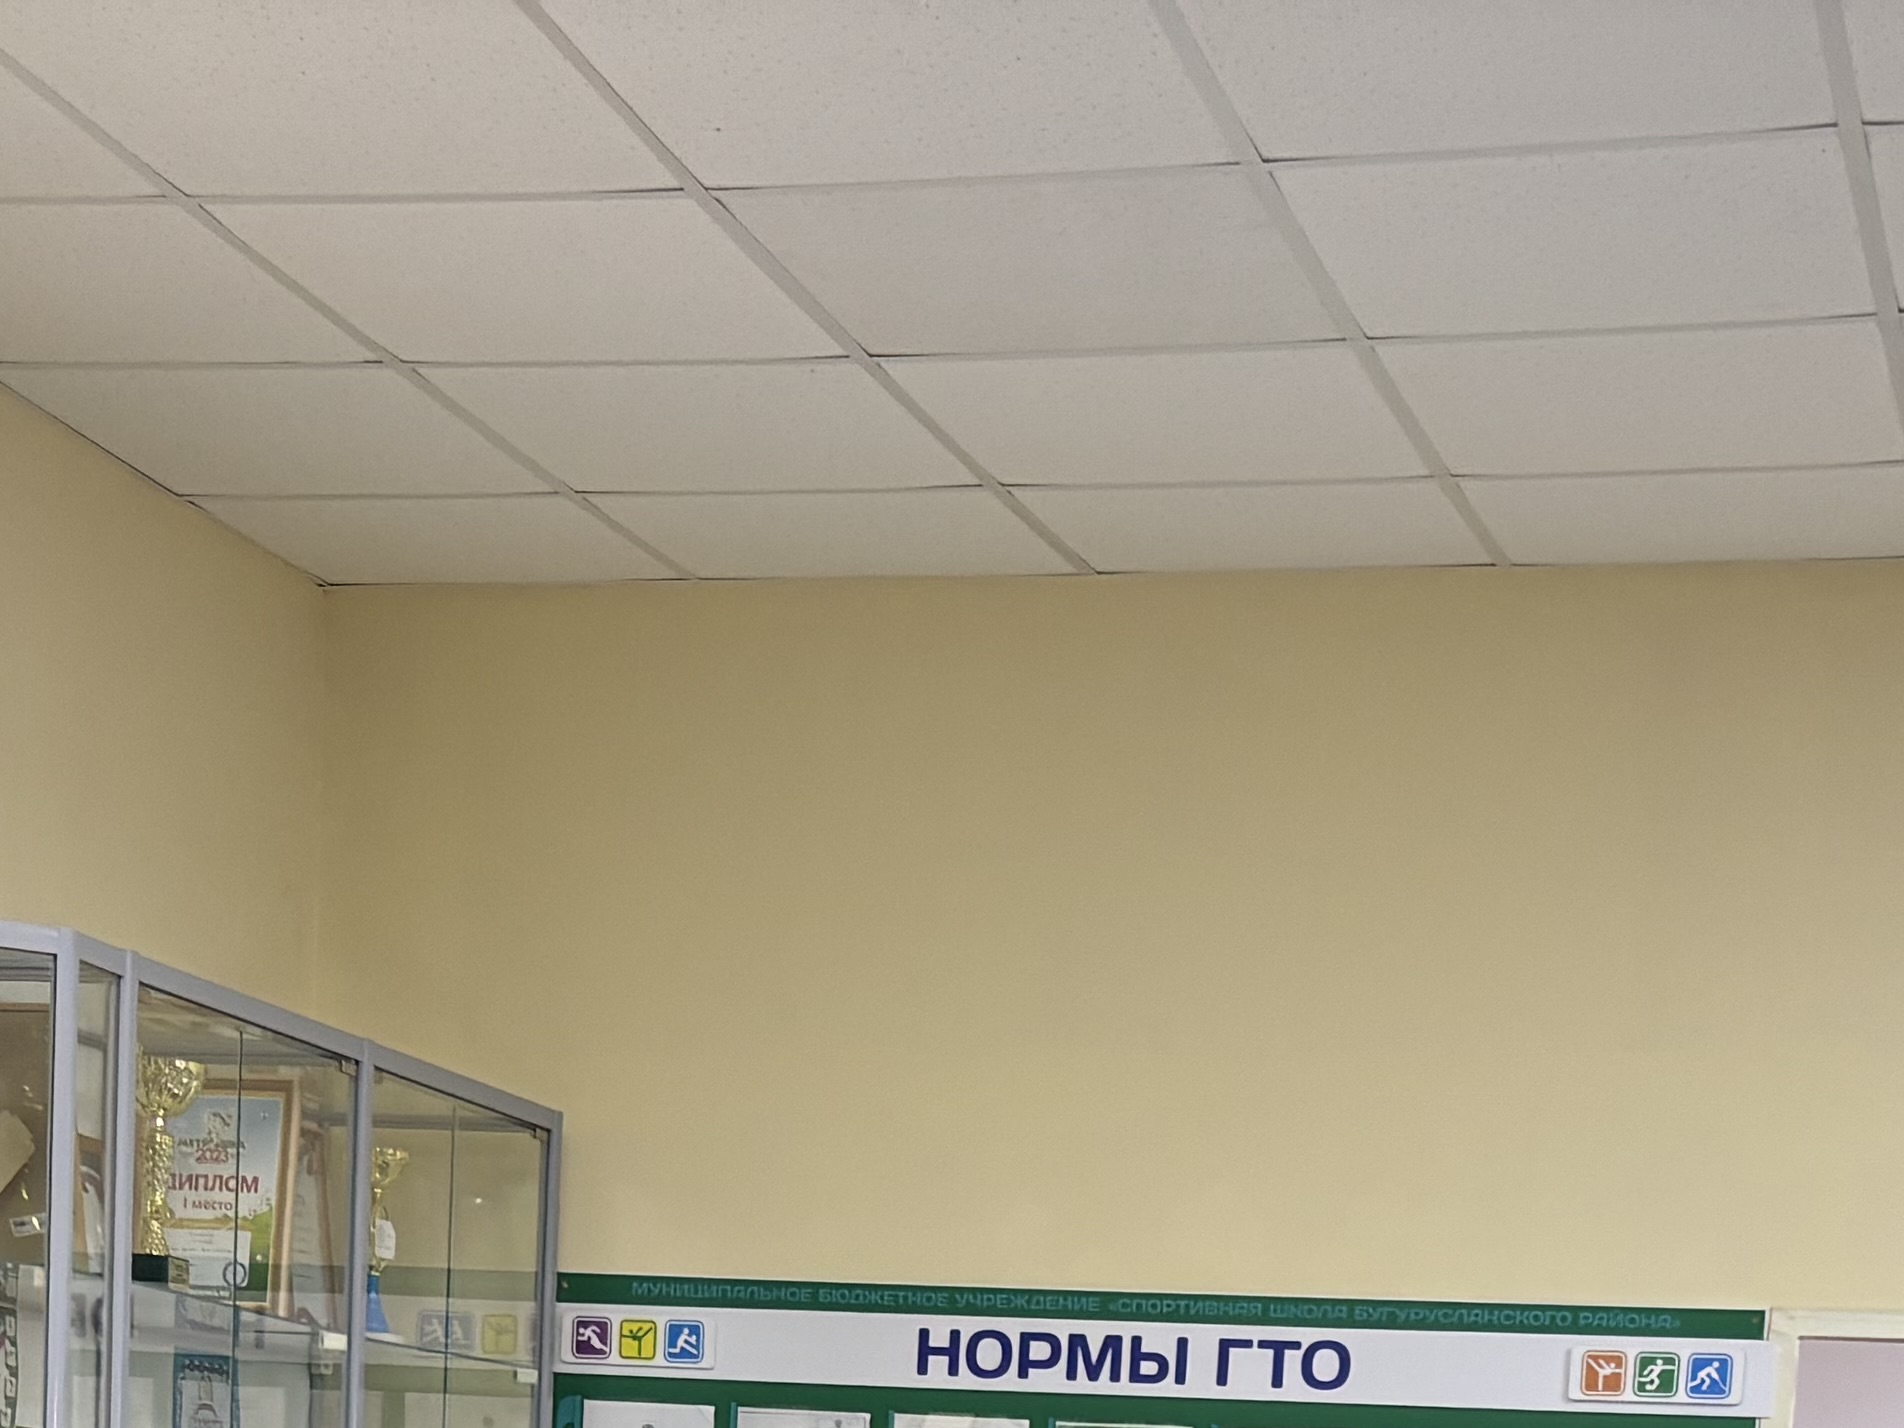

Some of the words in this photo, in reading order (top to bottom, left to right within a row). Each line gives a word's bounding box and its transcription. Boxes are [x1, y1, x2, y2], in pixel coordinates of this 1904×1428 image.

[632, 1280, 813, 1302] МУНИЦИПАЛЬНОЕ
[818, 1288, 951, 1308] БЮДЖЕТНОЕ
[955, 1293, 1101, 1313] УЧРЕЖДЕНИЕ
[1269, 1303, 1348, 1320] ШКОЛА
[1355, 1306, 1573, 1328] БУГУРУСЛАНСКОГО
[916, 1327, 1189, 1386] НОРМЫ
[1216, 1337, 1352, 1391] ГТО
